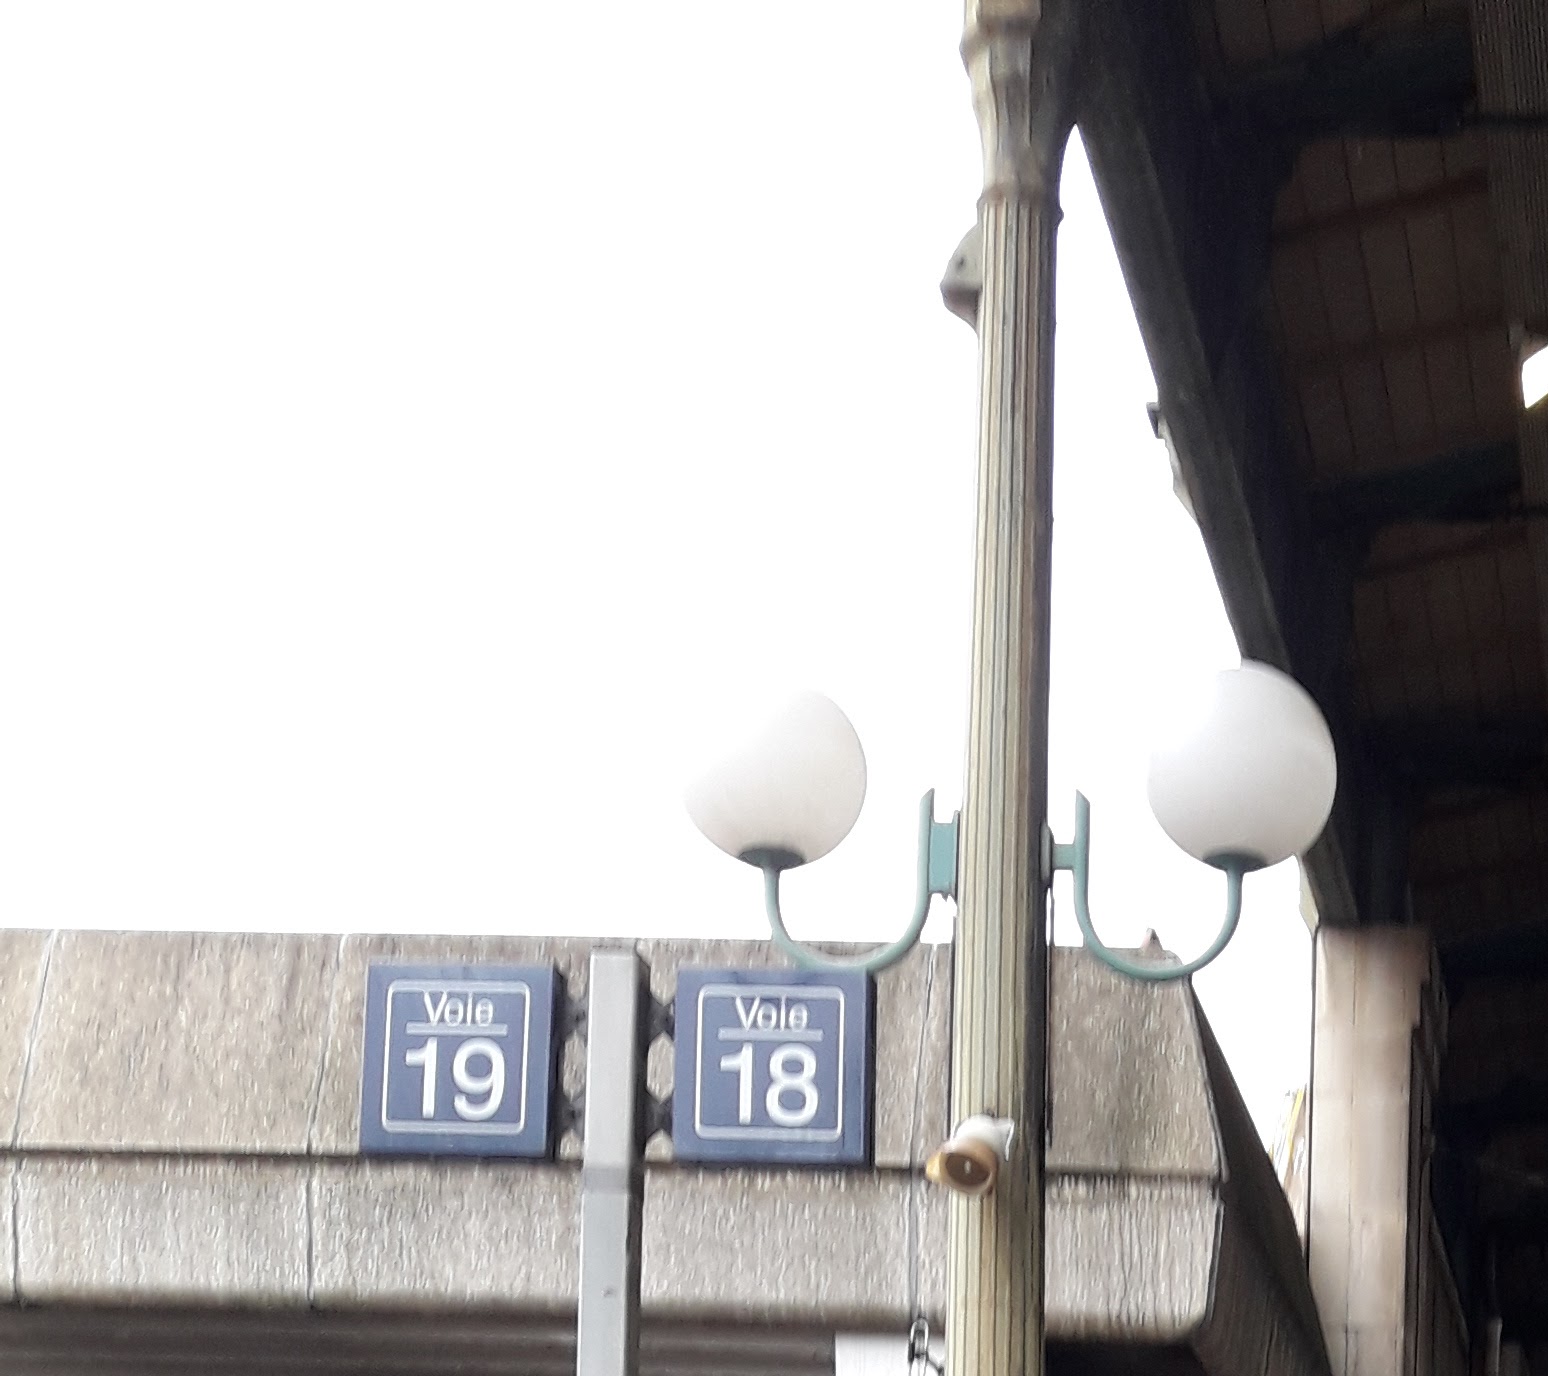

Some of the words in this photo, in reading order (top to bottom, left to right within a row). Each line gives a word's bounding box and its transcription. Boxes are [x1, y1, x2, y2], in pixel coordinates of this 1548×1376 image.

[423, 992, 495, 1026] Voie
[735, 995, 809, 1031] Voie
[405, 1037, 506, 1121] 19
[719, 1042, 819, 1128] 18
